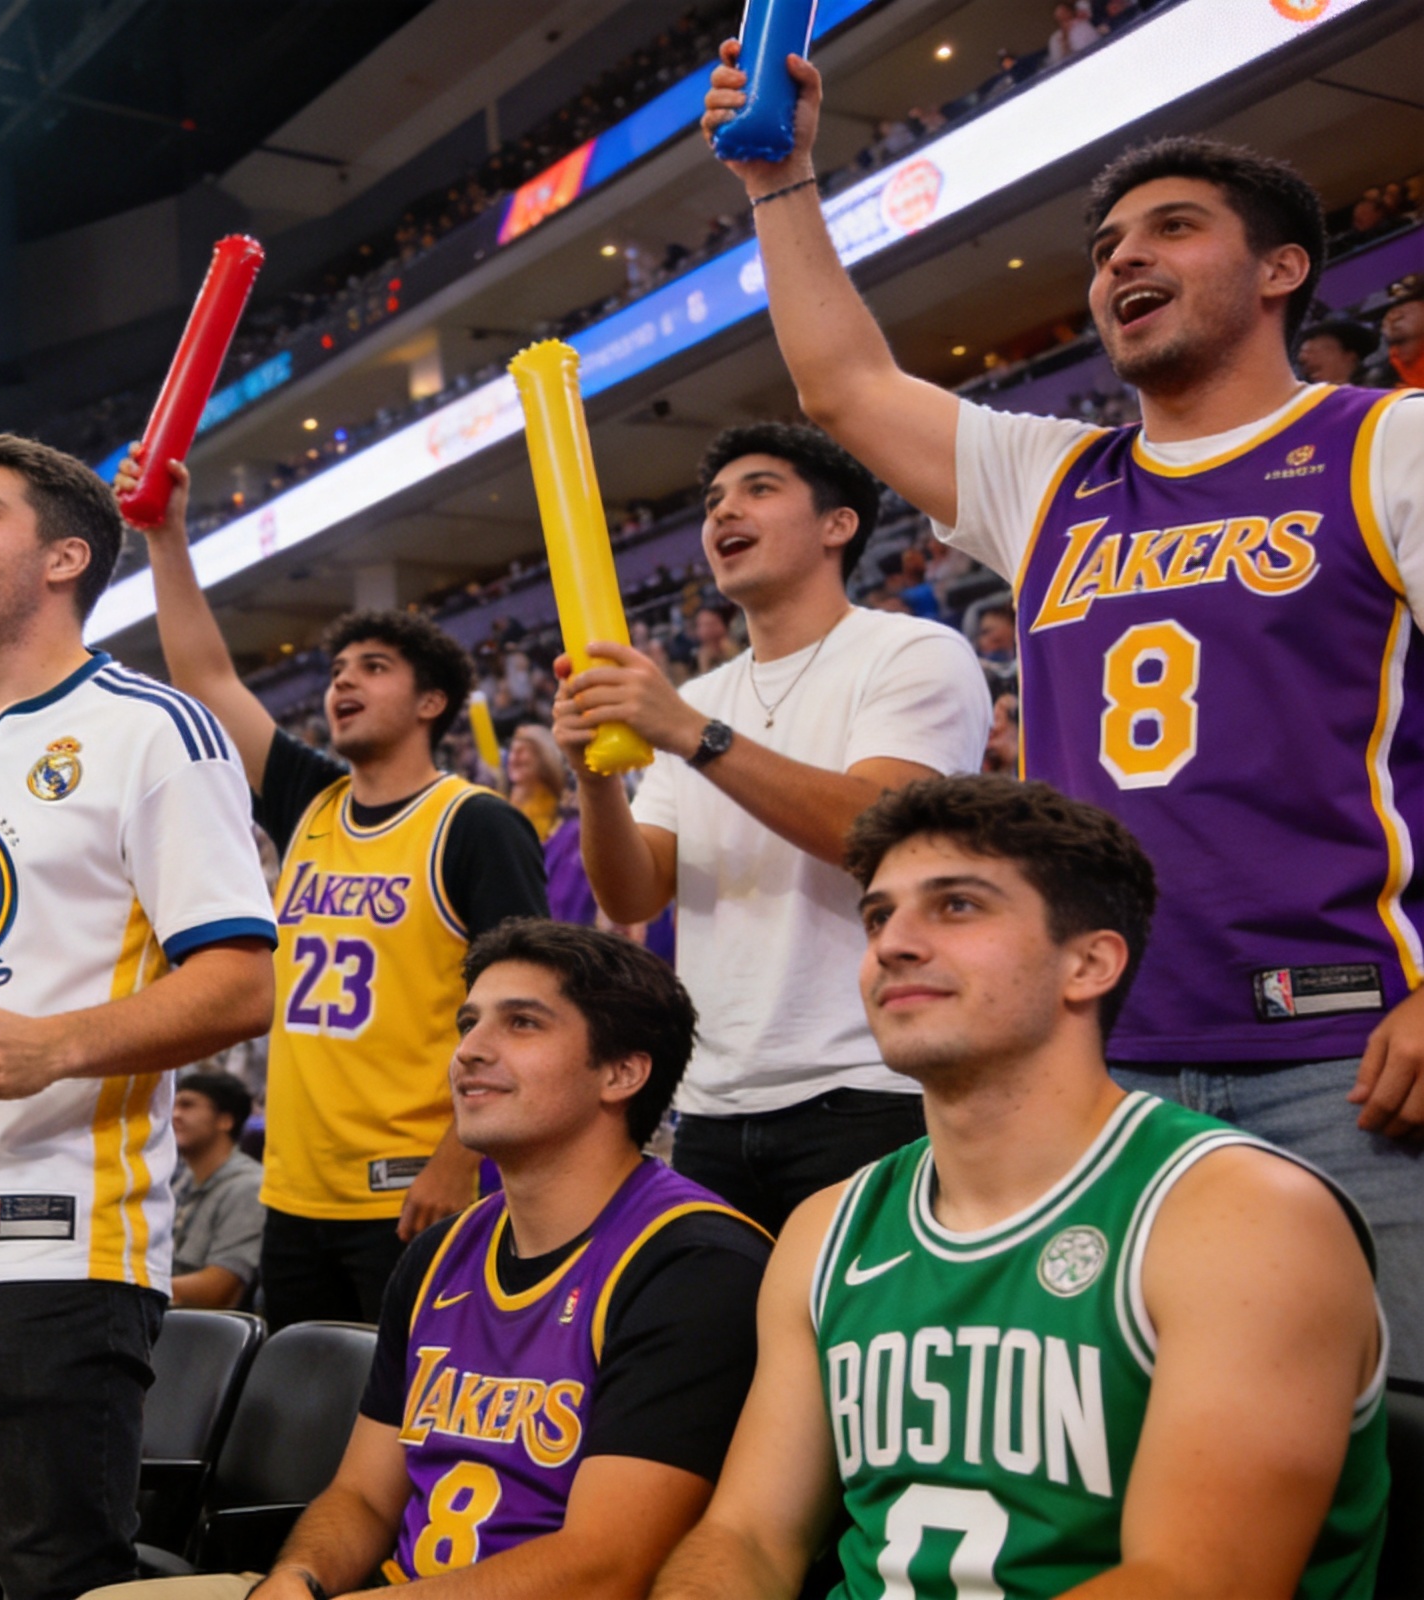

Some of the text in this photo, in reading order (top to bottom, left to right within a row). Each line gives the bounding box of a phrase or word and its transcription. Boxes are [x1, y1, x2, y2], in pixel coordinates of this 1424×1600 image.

[1029, 510, 1325, 634] LAKERS
[1099, 618, 1201, 790] 8
[277, 860, 413, 926] LAKERS
[285, 932, 376, 1041] 23
[397, 1345, 585, 1469] LAKERS
[827, 1325, 1114, 1499] BOSTON
[413, 1460, 502, 1579] 8
